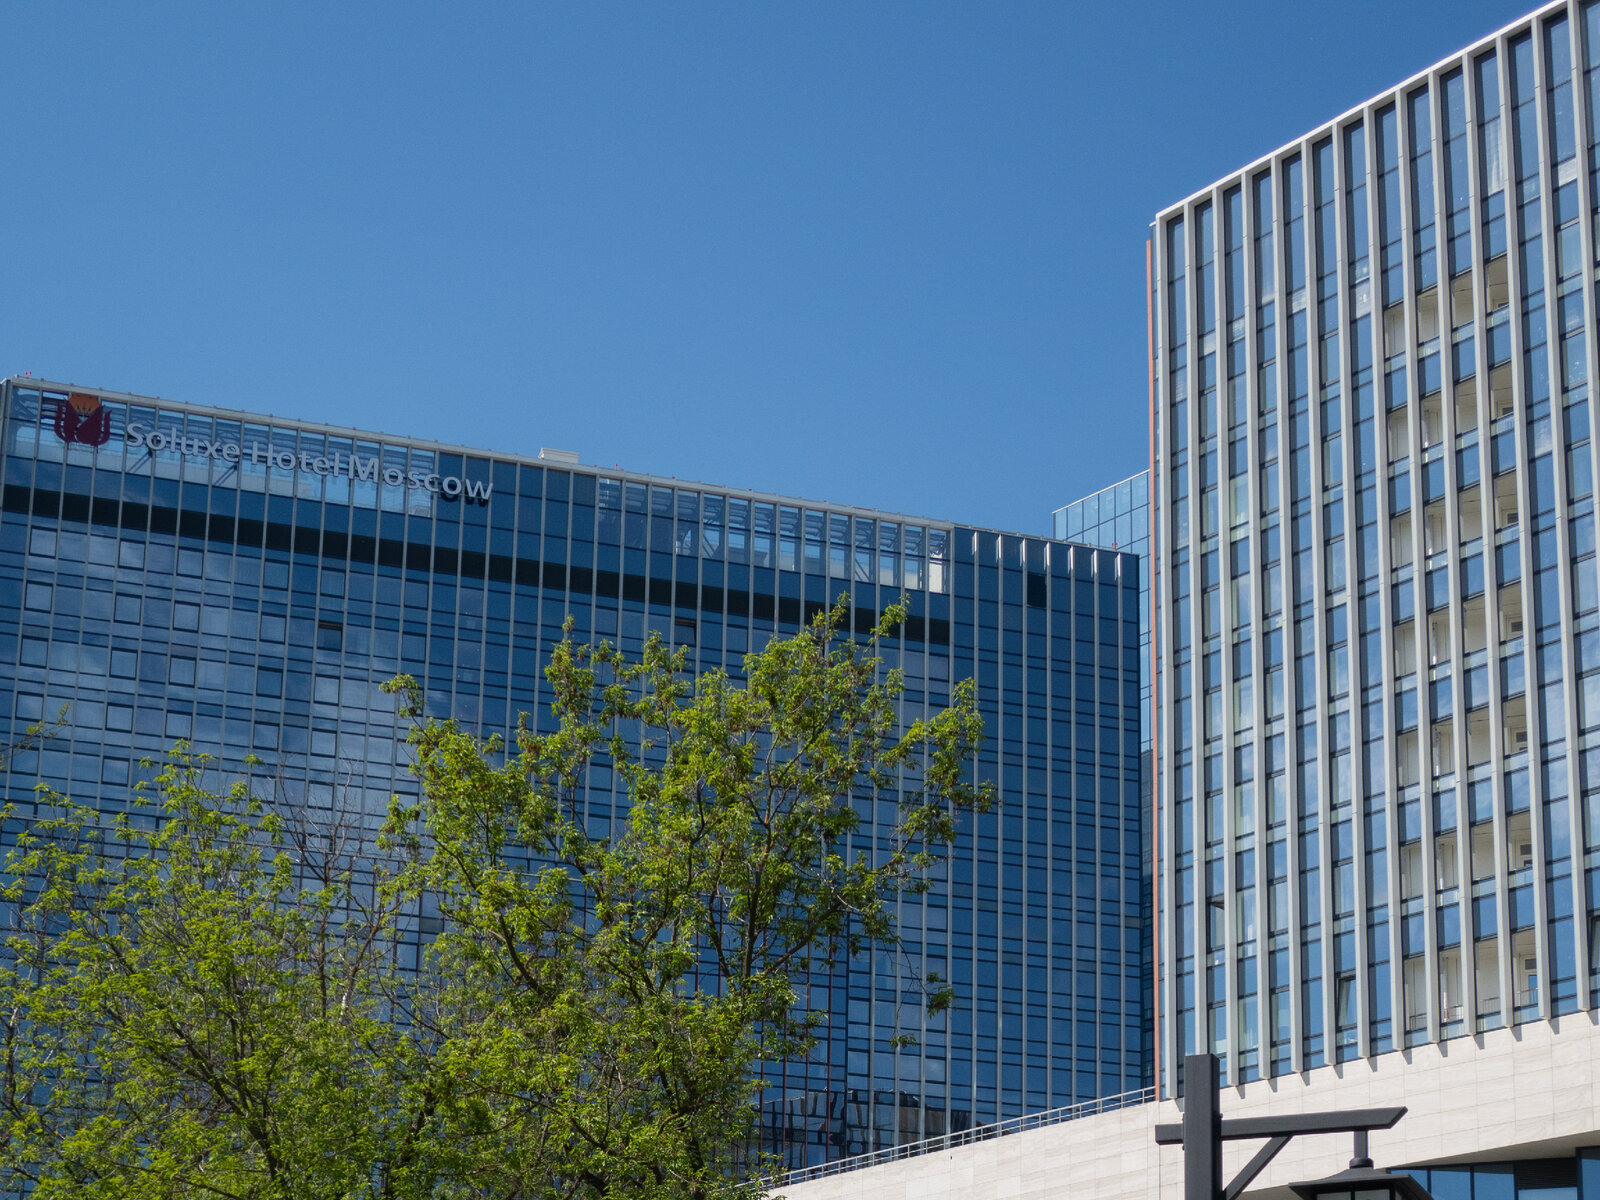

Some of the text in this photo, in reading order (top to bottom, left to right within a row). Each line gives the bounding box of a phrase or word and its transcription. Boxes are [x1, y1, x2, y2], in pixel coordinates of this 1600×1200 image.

[126, 423, 493, 500] Soluxe Hotel Moscow
